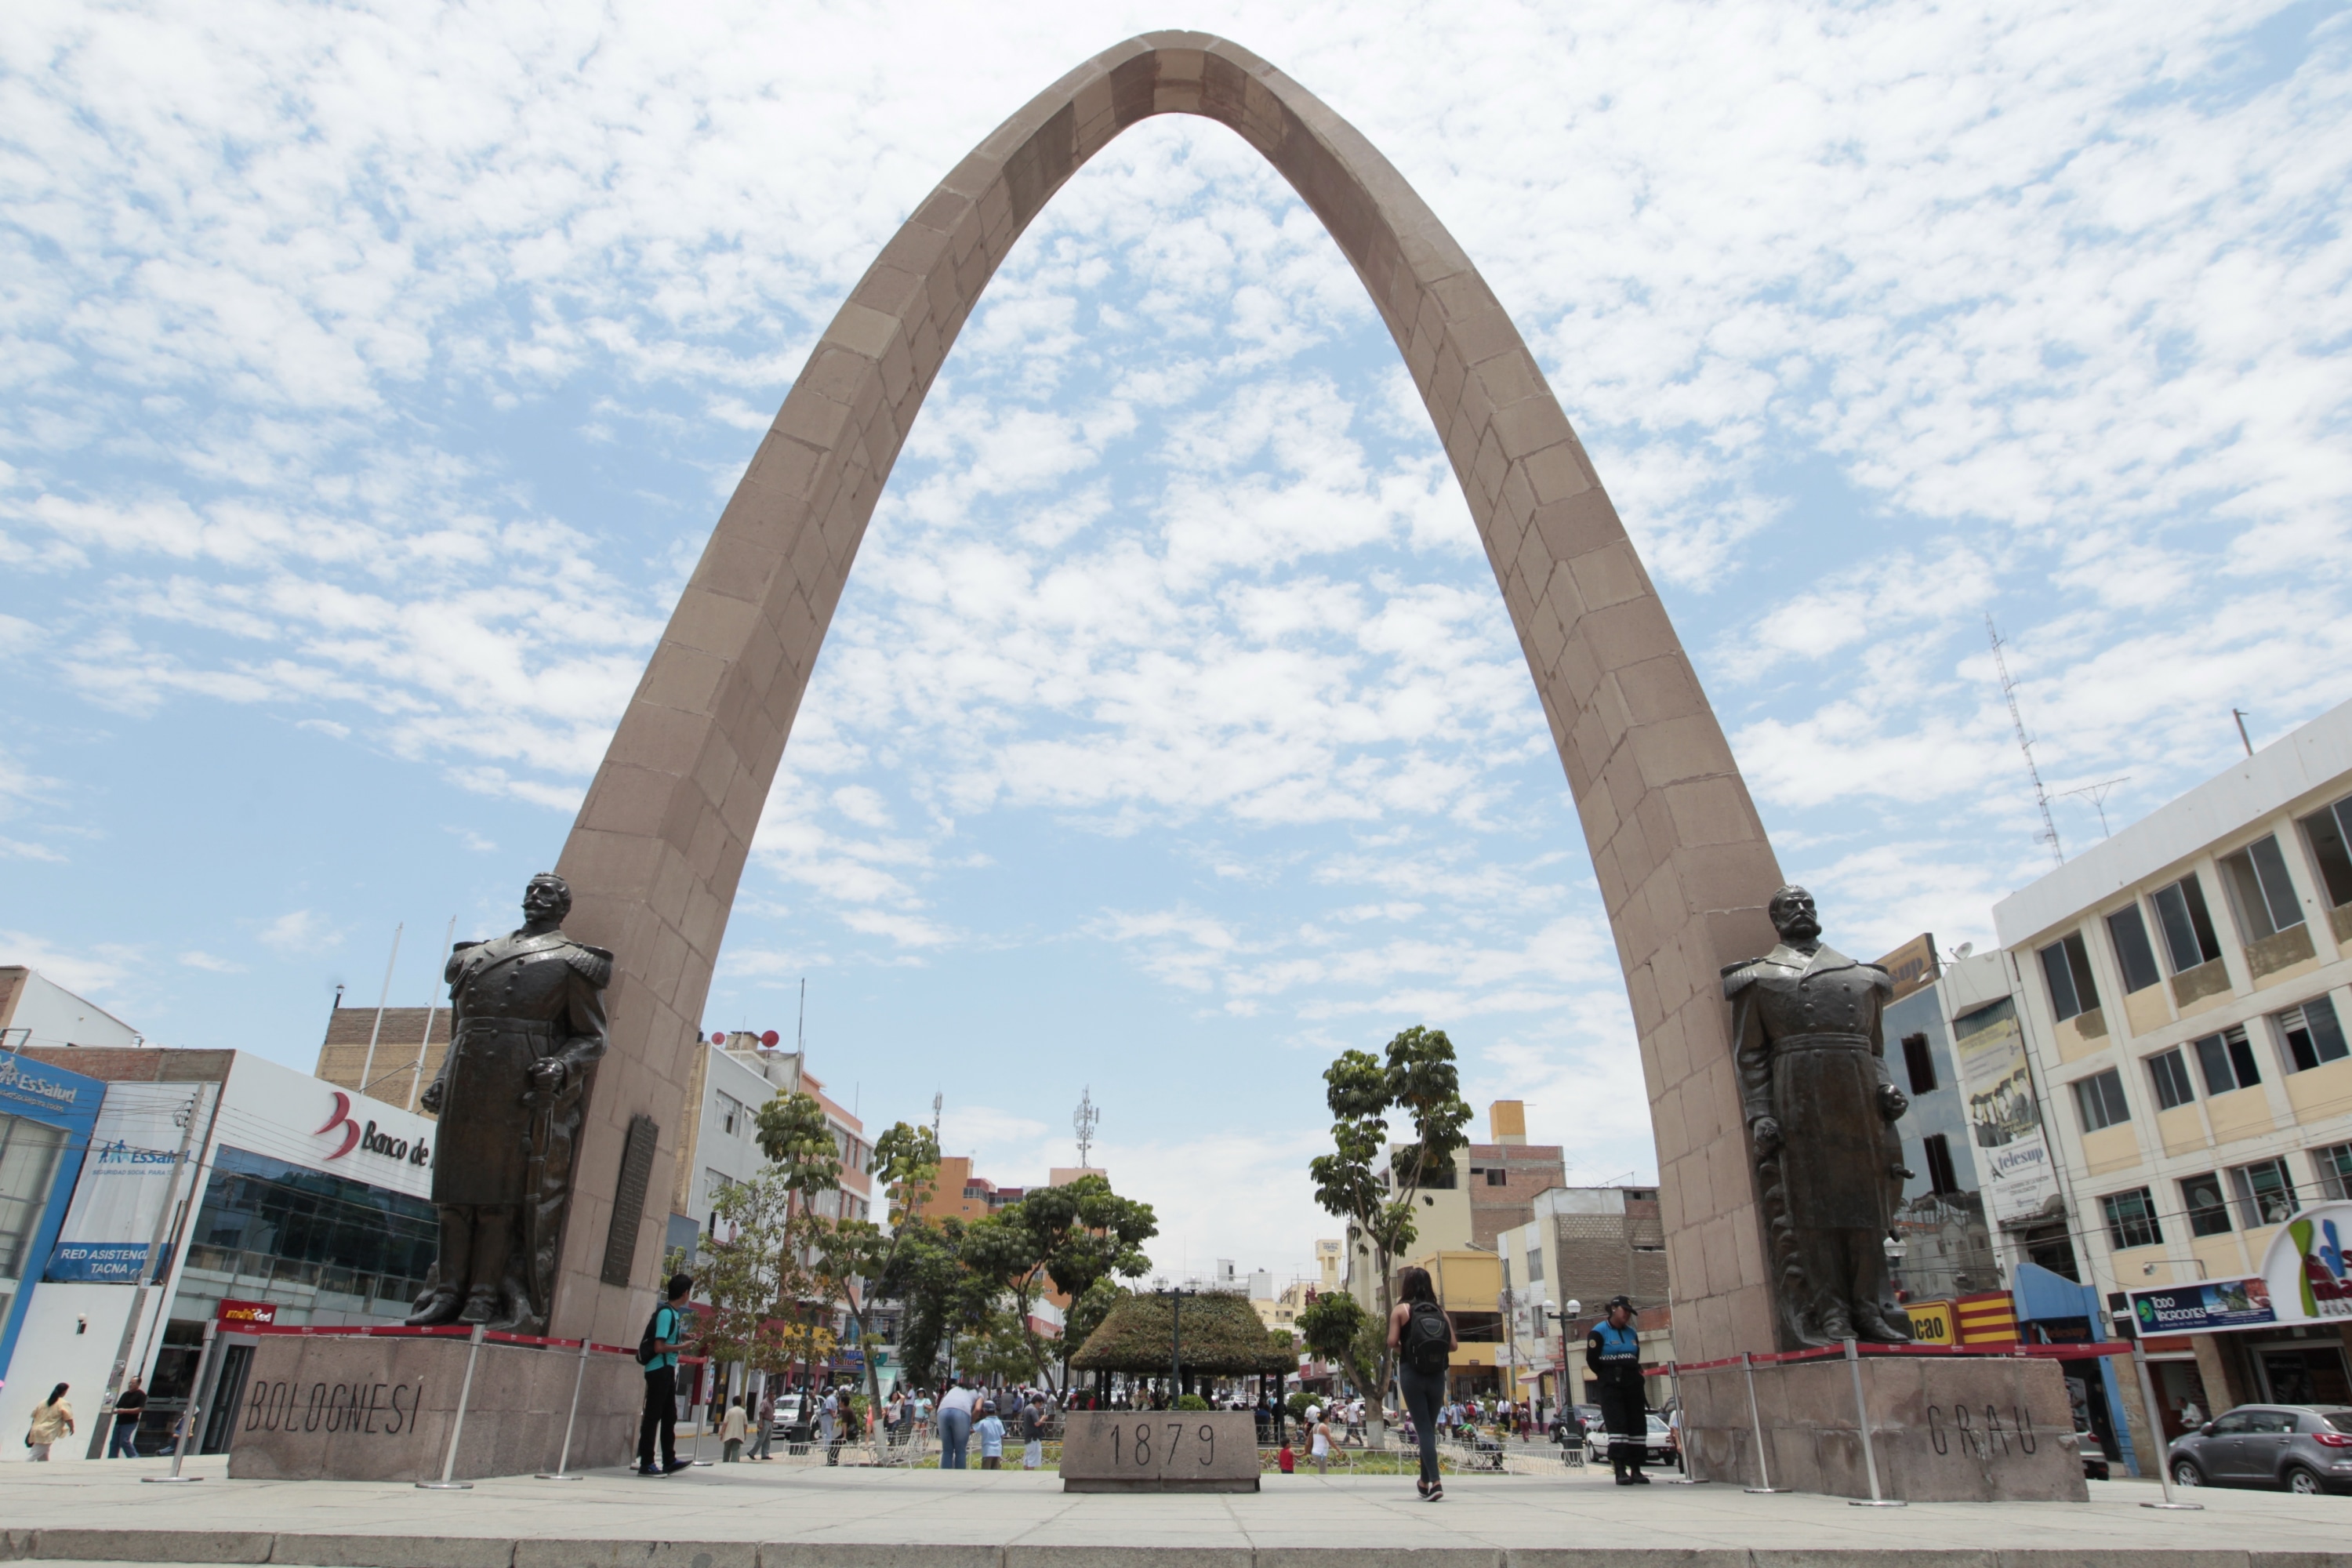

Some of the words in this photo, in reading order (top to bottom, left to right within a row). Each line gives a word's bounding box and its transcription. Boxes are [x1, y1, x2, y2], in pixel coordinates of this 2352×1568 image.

[18, 1073, 78, 1104] EsSalud
[361, 1120, 408, 1160] Banco
[410, 1137, 429, 1167] de
[1998, 1146, 2044, 1171] telesup
[60, 1248, 87, 1259] RED
[89, 1249, 159, 1261] ASISTENCI
[91, 1263, 128, 1274] TACNA
[245, 1381, 423, 1434] BOLOGNESI
[1110, 1423, 1214, 1466] 1879
[1926, 1404, 2037, 1457] GRAU
